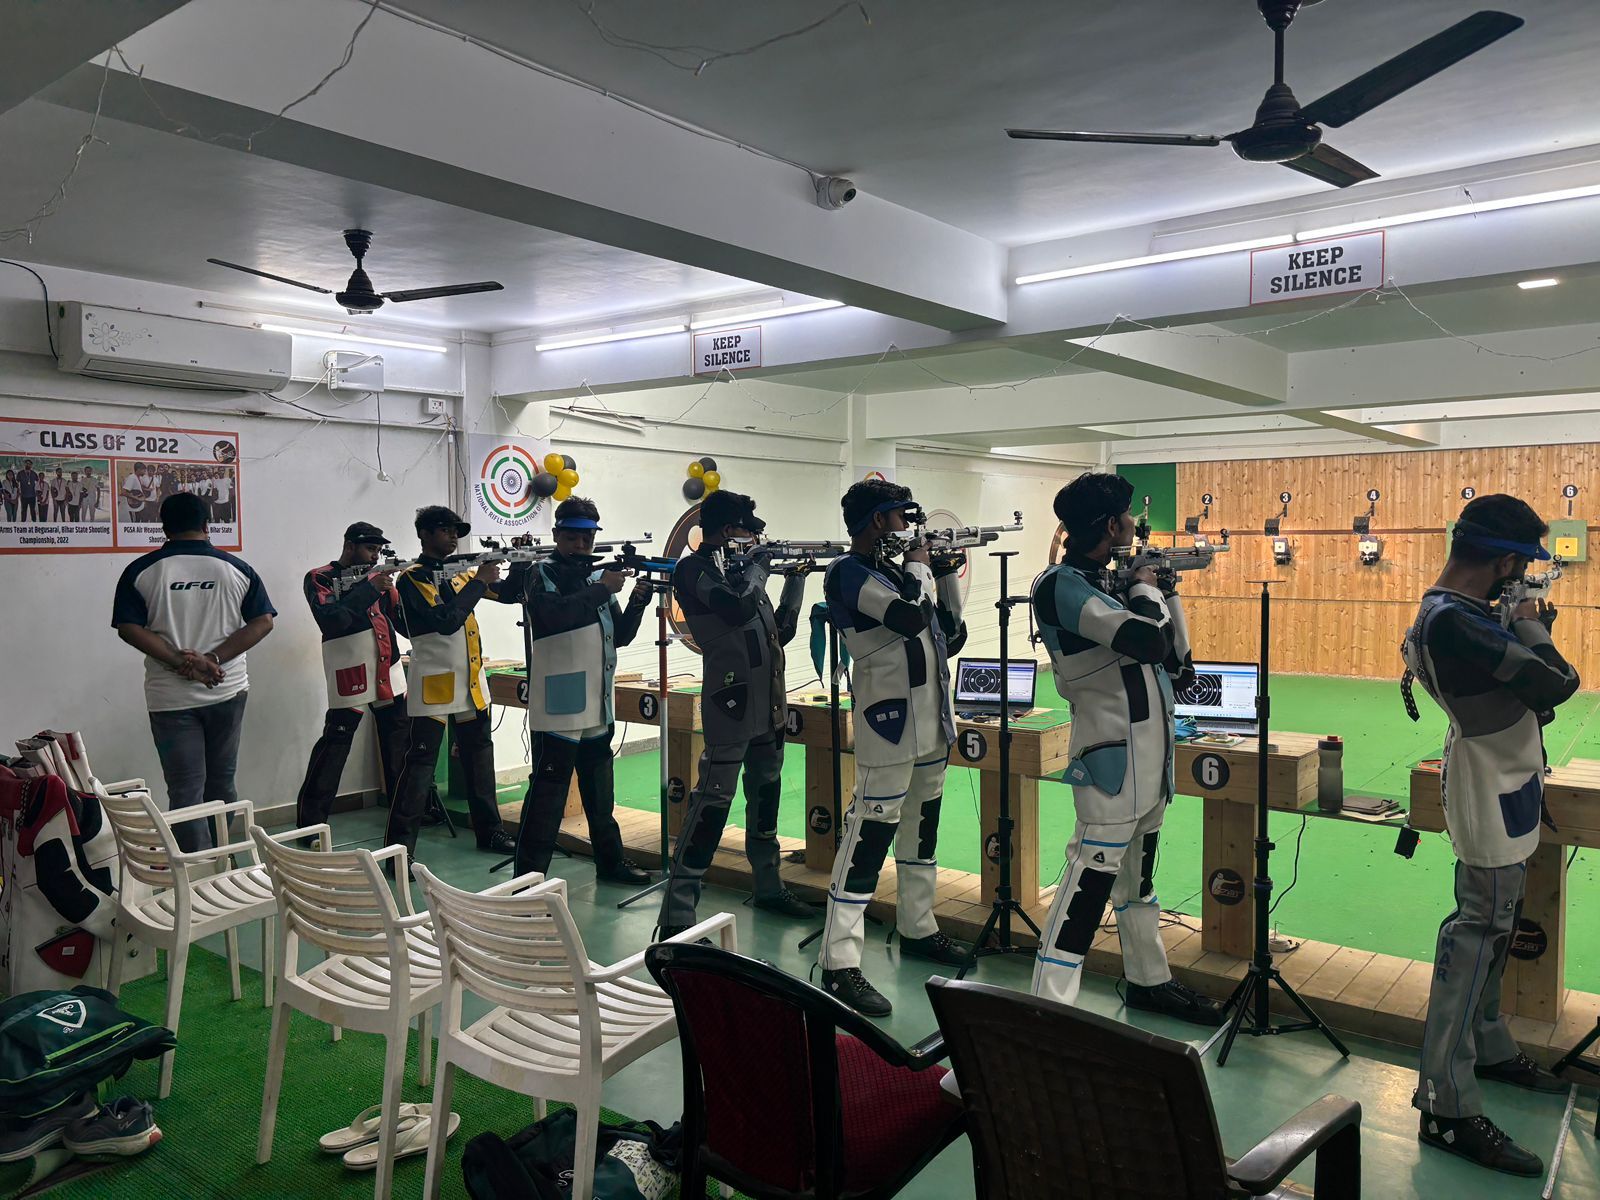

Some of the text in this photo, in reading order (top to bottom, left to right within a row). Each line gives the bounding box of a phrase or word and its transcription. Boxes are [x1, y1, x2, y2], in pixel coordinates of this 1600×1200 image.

[1288, 246, 1344, 271] KEEP
[1270, 265, 1362, 294] SILENCE
[712, 335, 741, 351] KEEP
[704, 349, 751, 367] SILENCE
[40, 430, 179, 454] CLASS OF 2022
[1204, 494, 1210, 504] 2
[1282, 492, 1289, 503] 3
[1369, 490, 1377, 500] 4
[1465, 488, 1473, 499] 5
[1566, 486, 1574, 497] 6
[474, 484, 489, 514] NATIONAL
[488, 511, 503, 525] RIFLE
[504, 510, 539, 527] ASSOCIATION
[88, 526, 110, 535] Shooting
[56, 536, 69, 544] 2022
[170, 581, 215, 591] GFG
[520, 682, 528, 701] 2
[644, 696, 653, 716] 3
[786, 711, 797, 733] 4
[966, 732, 980, 758] 5
[1202, 757, 1219, 786] 6
